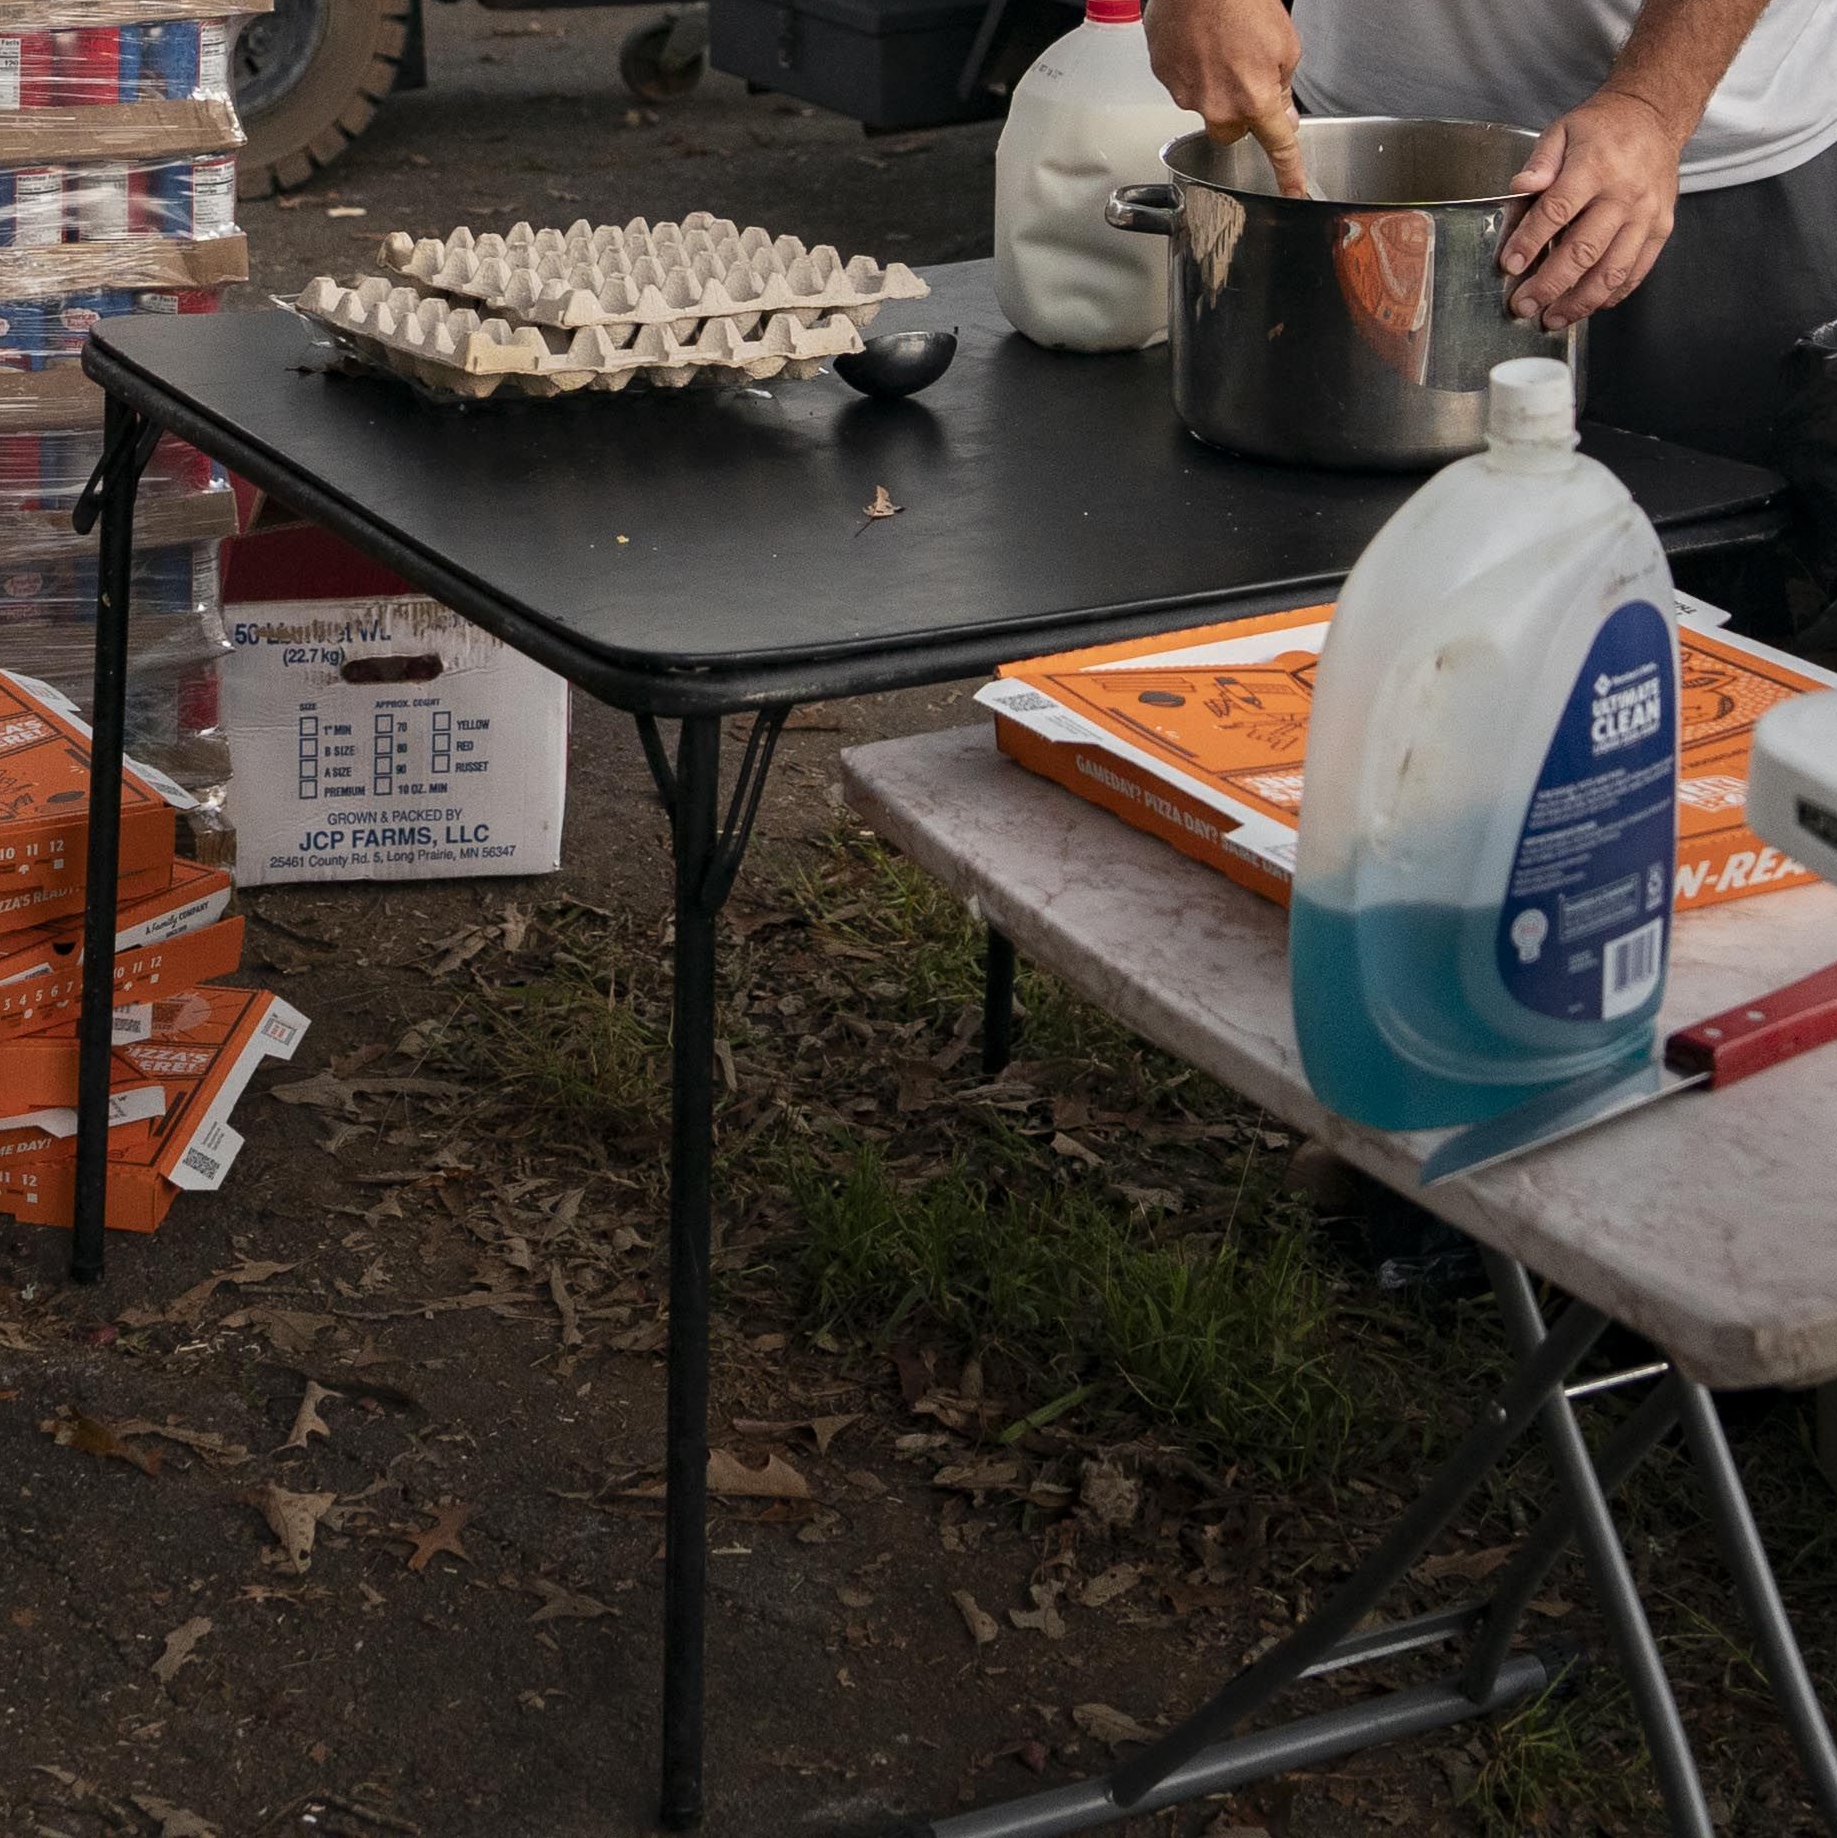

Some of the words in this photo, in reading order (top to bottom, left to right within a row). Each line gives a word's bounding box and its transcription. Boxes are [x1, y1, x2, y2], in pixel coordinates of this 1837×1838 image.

[234, 623, 260, 645] 50
[283, 648, 318, 667] (22.7
[321, 646, 345, 666] kg)
[299, 703, 317, 711] SIZE
[375, 700, 410, 709] APPROX.
[412, 697, 441, 708] COUNT
[1592, 677, 1659, 718] ULTIMATE
[456, 719, 491, 731] YELLOW
[1591, 694, 1659, 742] CLEAN
[335, 724, 352, 736] MIN
[397, 722, 408, 733] 70
[325, 746, 331, 756] B
[334, 745, 356, 757] SIZE
[397, 743, 408, 754] 80
[456, 741, 474, 752] RED
[324, 767, 332, 778] A
[333, 766, 353, 778] SIZE
[396, 764, 407, 775] 90
[455, 761, 489, 774] RUSSET
[324, 785, 366, 798] PREMIUM
[398, 785, 409, 795] 10
[410, 784, 426, 795] OZ.
[429, 783, 448, 794] MIN
[1075, 753, 1142, 803] GAMEDAY?
[1144, 790, 1181, 826] PIZZA
[1182, 811, 1219, 843] DAY?
[327, 812, 377, 825] GROWN
[380, 811, 389, 824] &
[391, 809, 443, 823] PACKED
[445, 808, 463, 821] BY
[299, 830, 344, 852] JCP
[351, 827, 438, 849] FARMS,
[445, 824, 490, 844] LLC
[25, 843, 39, 856] 11
[48, 840, 65, 853] 12
[270, 855, 305, 868] 25461
[308, 854, 349, 868] County
[351, 852, 369, 864] Rd.
[373, 852, 383, 864] 5,
[387, 849, 414, 864] Long
[418, 847, 457, 862] Prairie,
[460, 847, 479, 859] MN
[481, 845, 517, 858] 56347
[178, 900, 209, 921] COMPANY
[3, 998, 11, 1011] 3
[18, 993, 28, 1006] 4
[35, 989, 43, 1001] 5
[50, 984, 59, 997] 6
[66, 980, 74, 993] 7
[132, 961, 144, 974] 11
[150, 956, 162, 969] 12
[138, 1061, 201, 1073] ERE!
[16, 1138, 52, 1154] DAY!
[21, 1173, 38, 1187] 12
